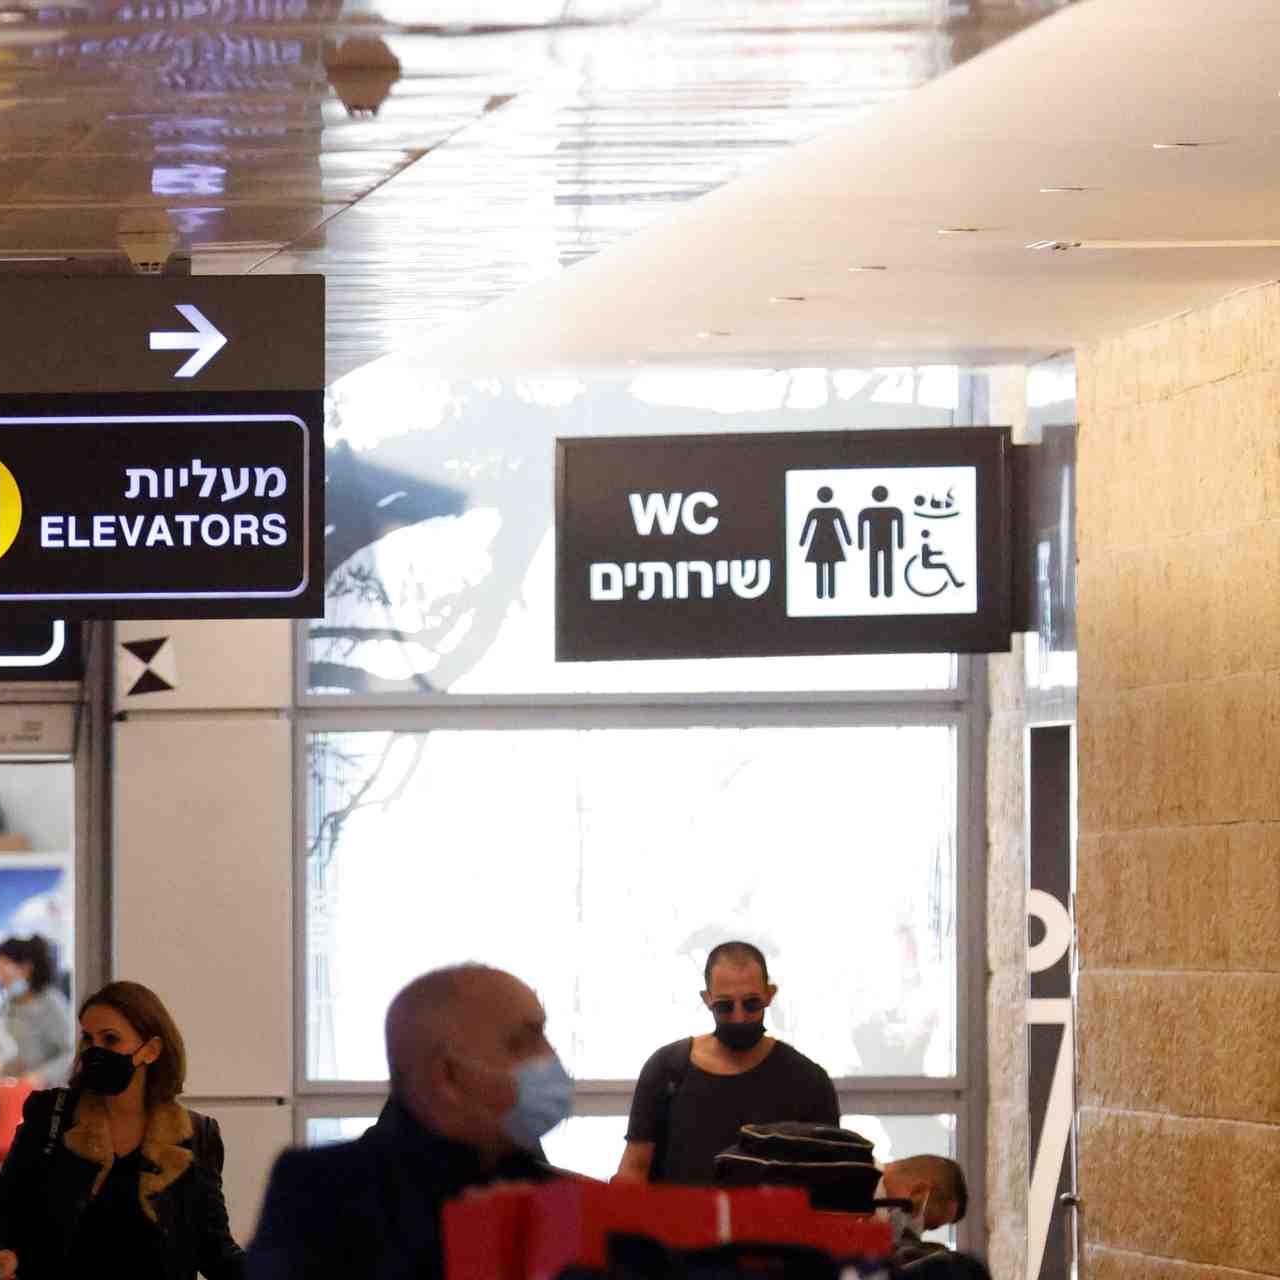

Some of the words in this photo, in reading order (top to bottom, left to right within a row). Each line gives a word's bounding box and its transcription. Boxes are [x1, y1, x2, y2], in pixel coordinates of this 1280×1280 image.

[124, 459, 288, 502] מעליות
[40, 513, 288, 549] ELEVATORS
[628, 491, 720, 536] WC
[589, 558, 771, 601] שירותים
